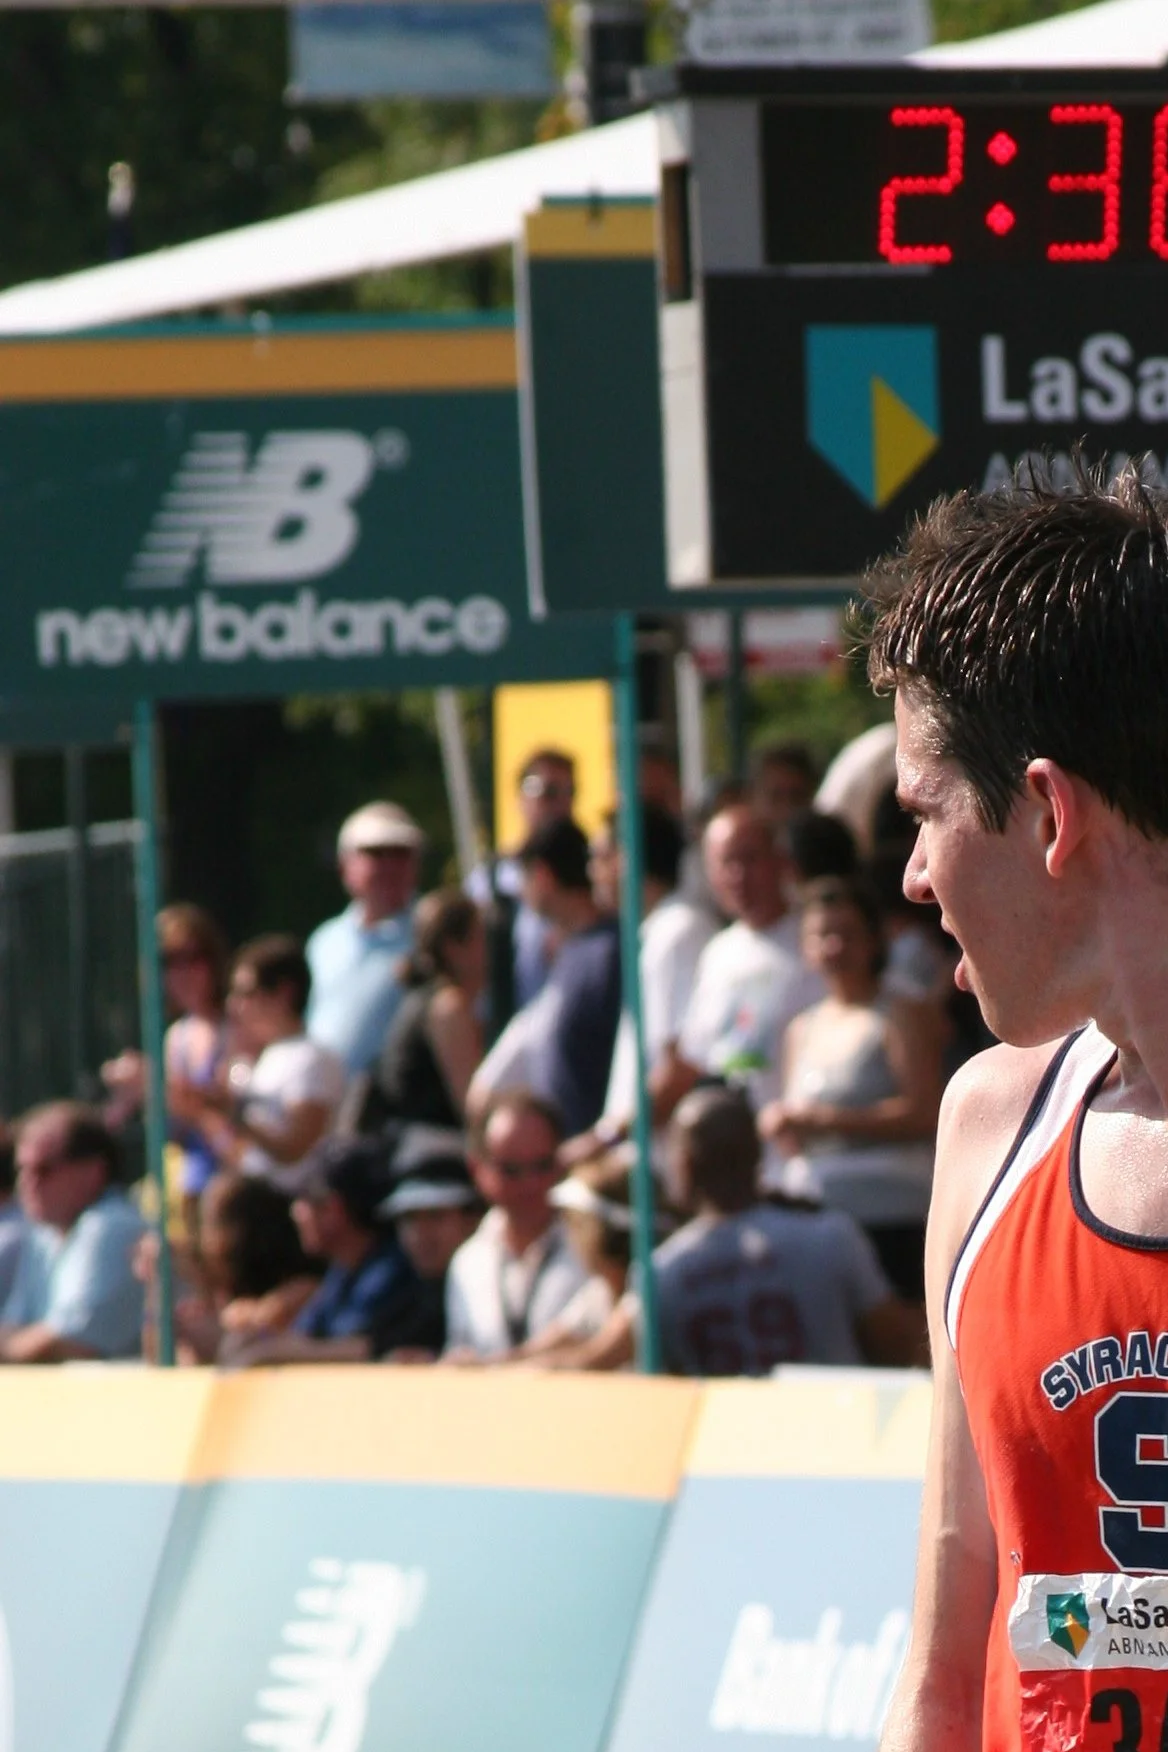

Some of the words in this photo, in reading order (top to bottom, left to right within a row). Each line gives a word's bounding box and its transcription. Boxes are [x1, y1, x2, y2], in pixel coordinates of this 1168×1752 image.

[35, 604, 192, 667] new
[197, 588, 510, 662] balance
[708, 1602, 845, 1738] Bank
